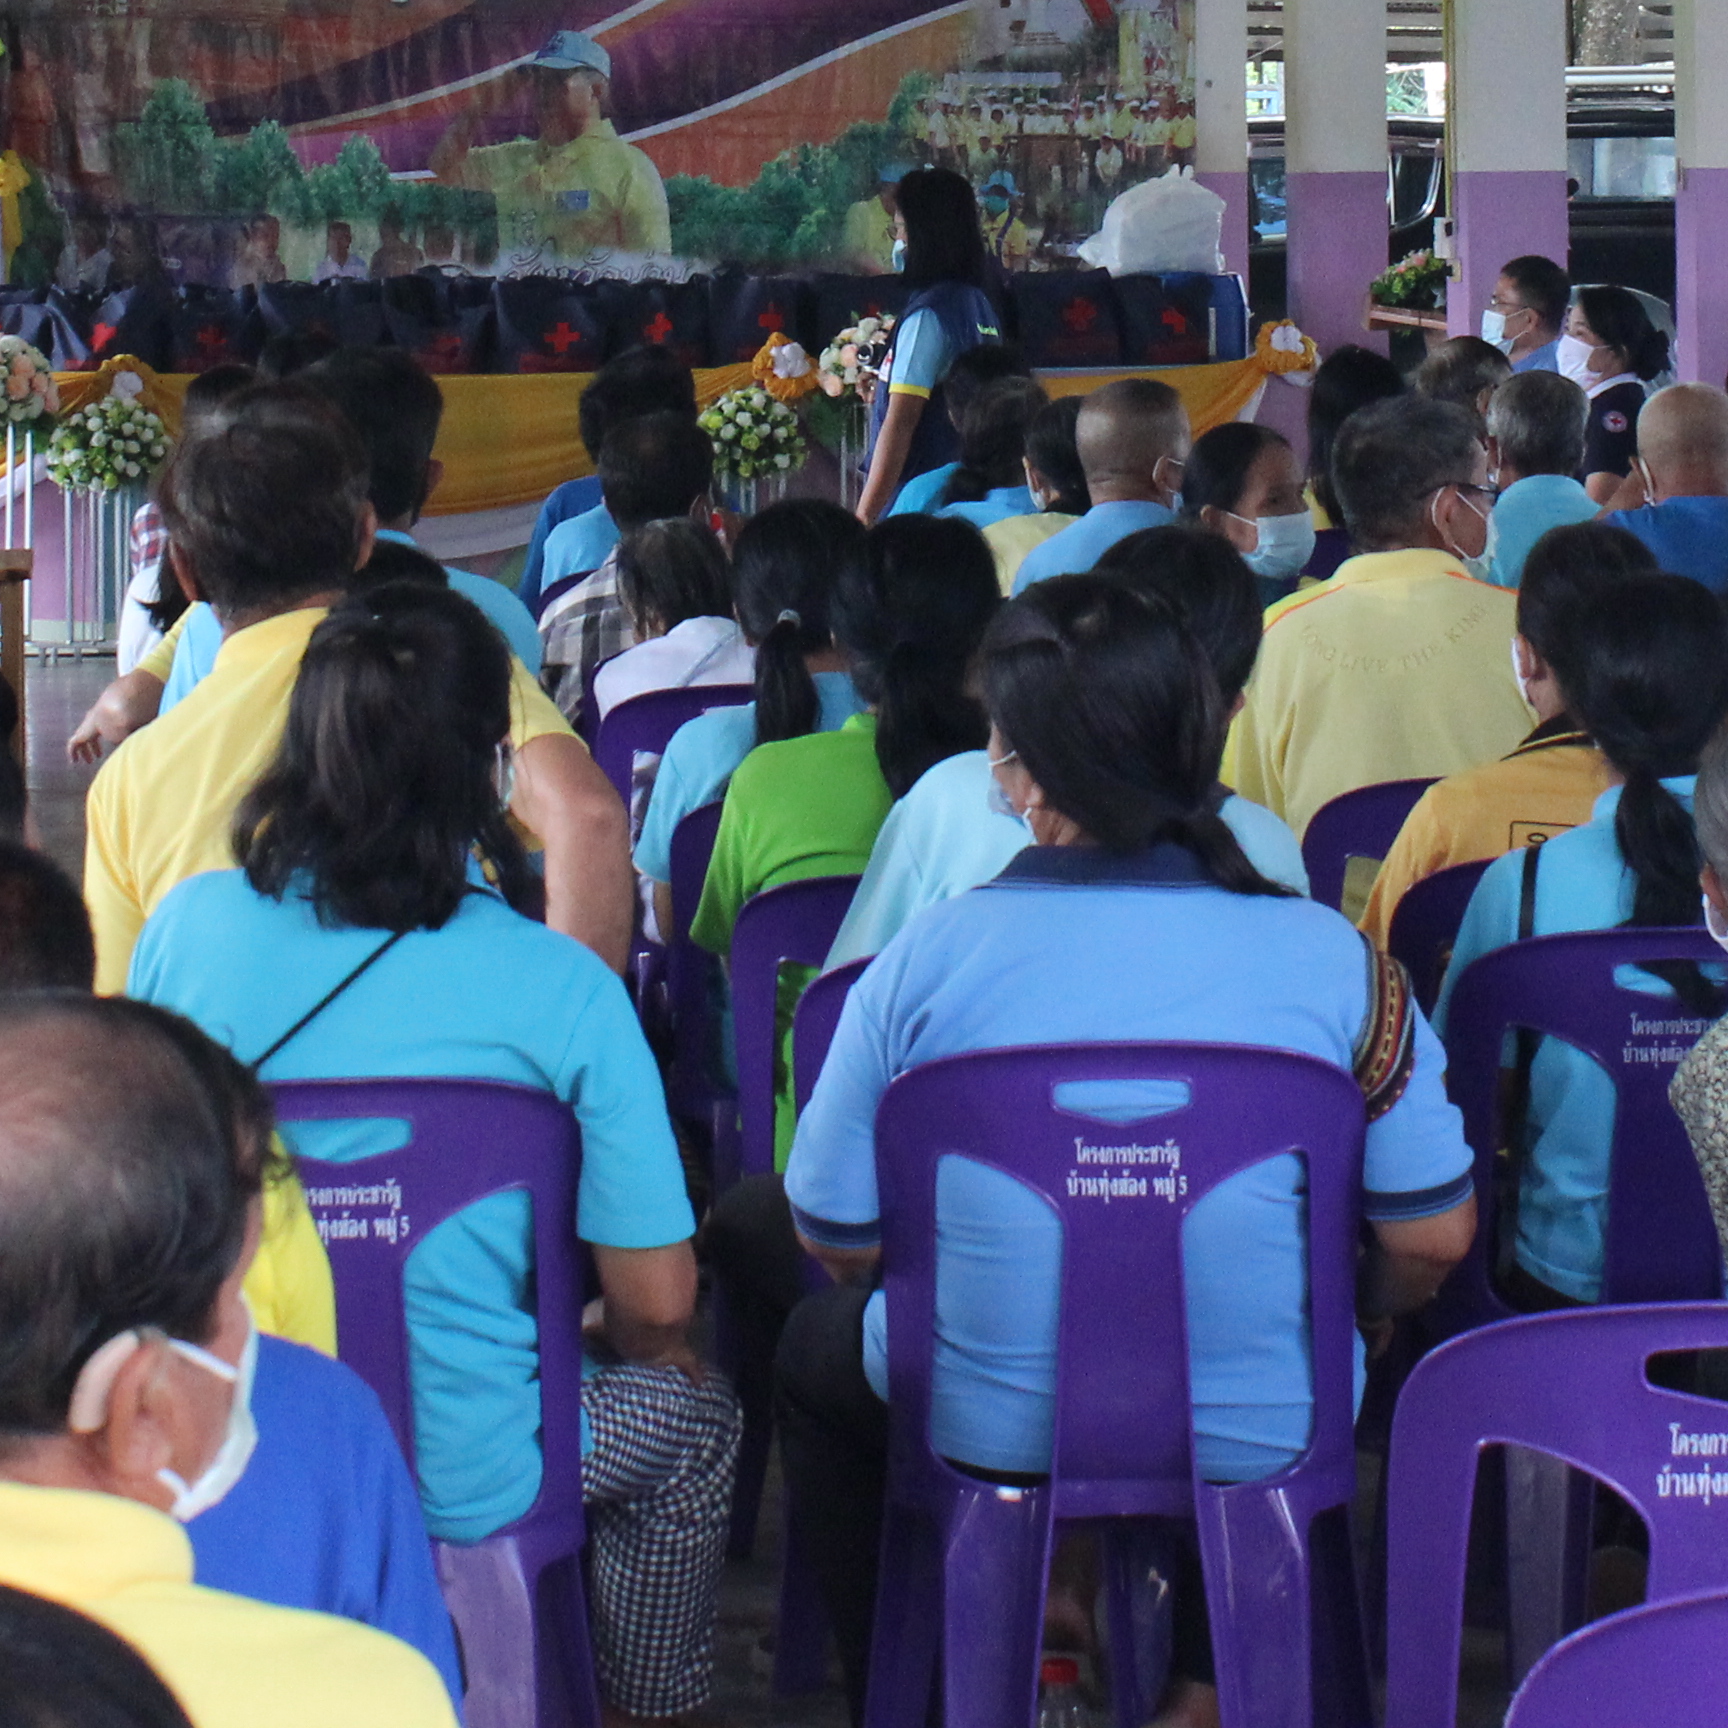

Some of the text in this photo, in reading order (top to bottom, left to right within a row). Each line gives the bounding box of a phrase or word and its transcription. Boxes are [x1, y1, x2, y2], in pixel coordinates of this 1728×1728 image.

[1074, 1137, 1180, 1170] โครงการประชารัฐ
[1178, 1175, 1188, 1195] 5
[400, 1215, 410, 1237] 5
